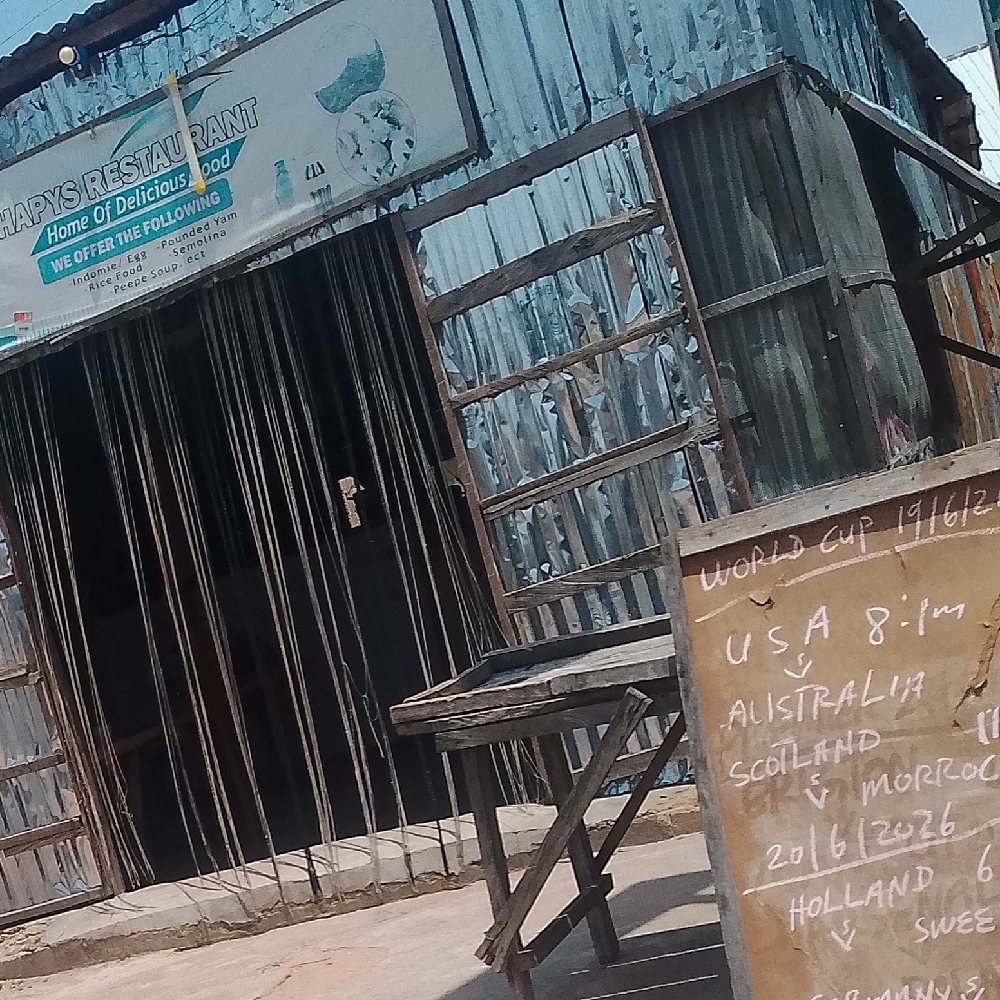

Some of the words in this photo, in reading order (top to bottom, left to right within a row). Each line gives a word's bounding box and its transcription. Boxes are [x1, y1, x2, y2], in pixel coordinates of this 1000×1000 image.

[82, 97, 258, 201] RESTAURANT
[47, 215, 89, 244] Home
[93, 200, 112, 224] Of
[116, 172, 187, 214] Delicious
[189, 148, 231, 188] ood
[213, 211, 238, 226] Yam
[50, 254, 72, 274] WE
[73, 237, 116, 264] OFFER
[116, 225, 142, 246] THE
[142, 191, 221, 235] FOLLOWING
[115, 263, 143, 281] Food
[701, 534, 806, 592] WORLD
[820, 515, 874, 554] CUP
[897, 485, 1000, 540] 19/6/2
[720, 669, 925, 731] AUSTRALIA
[729, 728, 881, 788] SCOTLAND
[789, 865, 934, 931] HOLLAND
